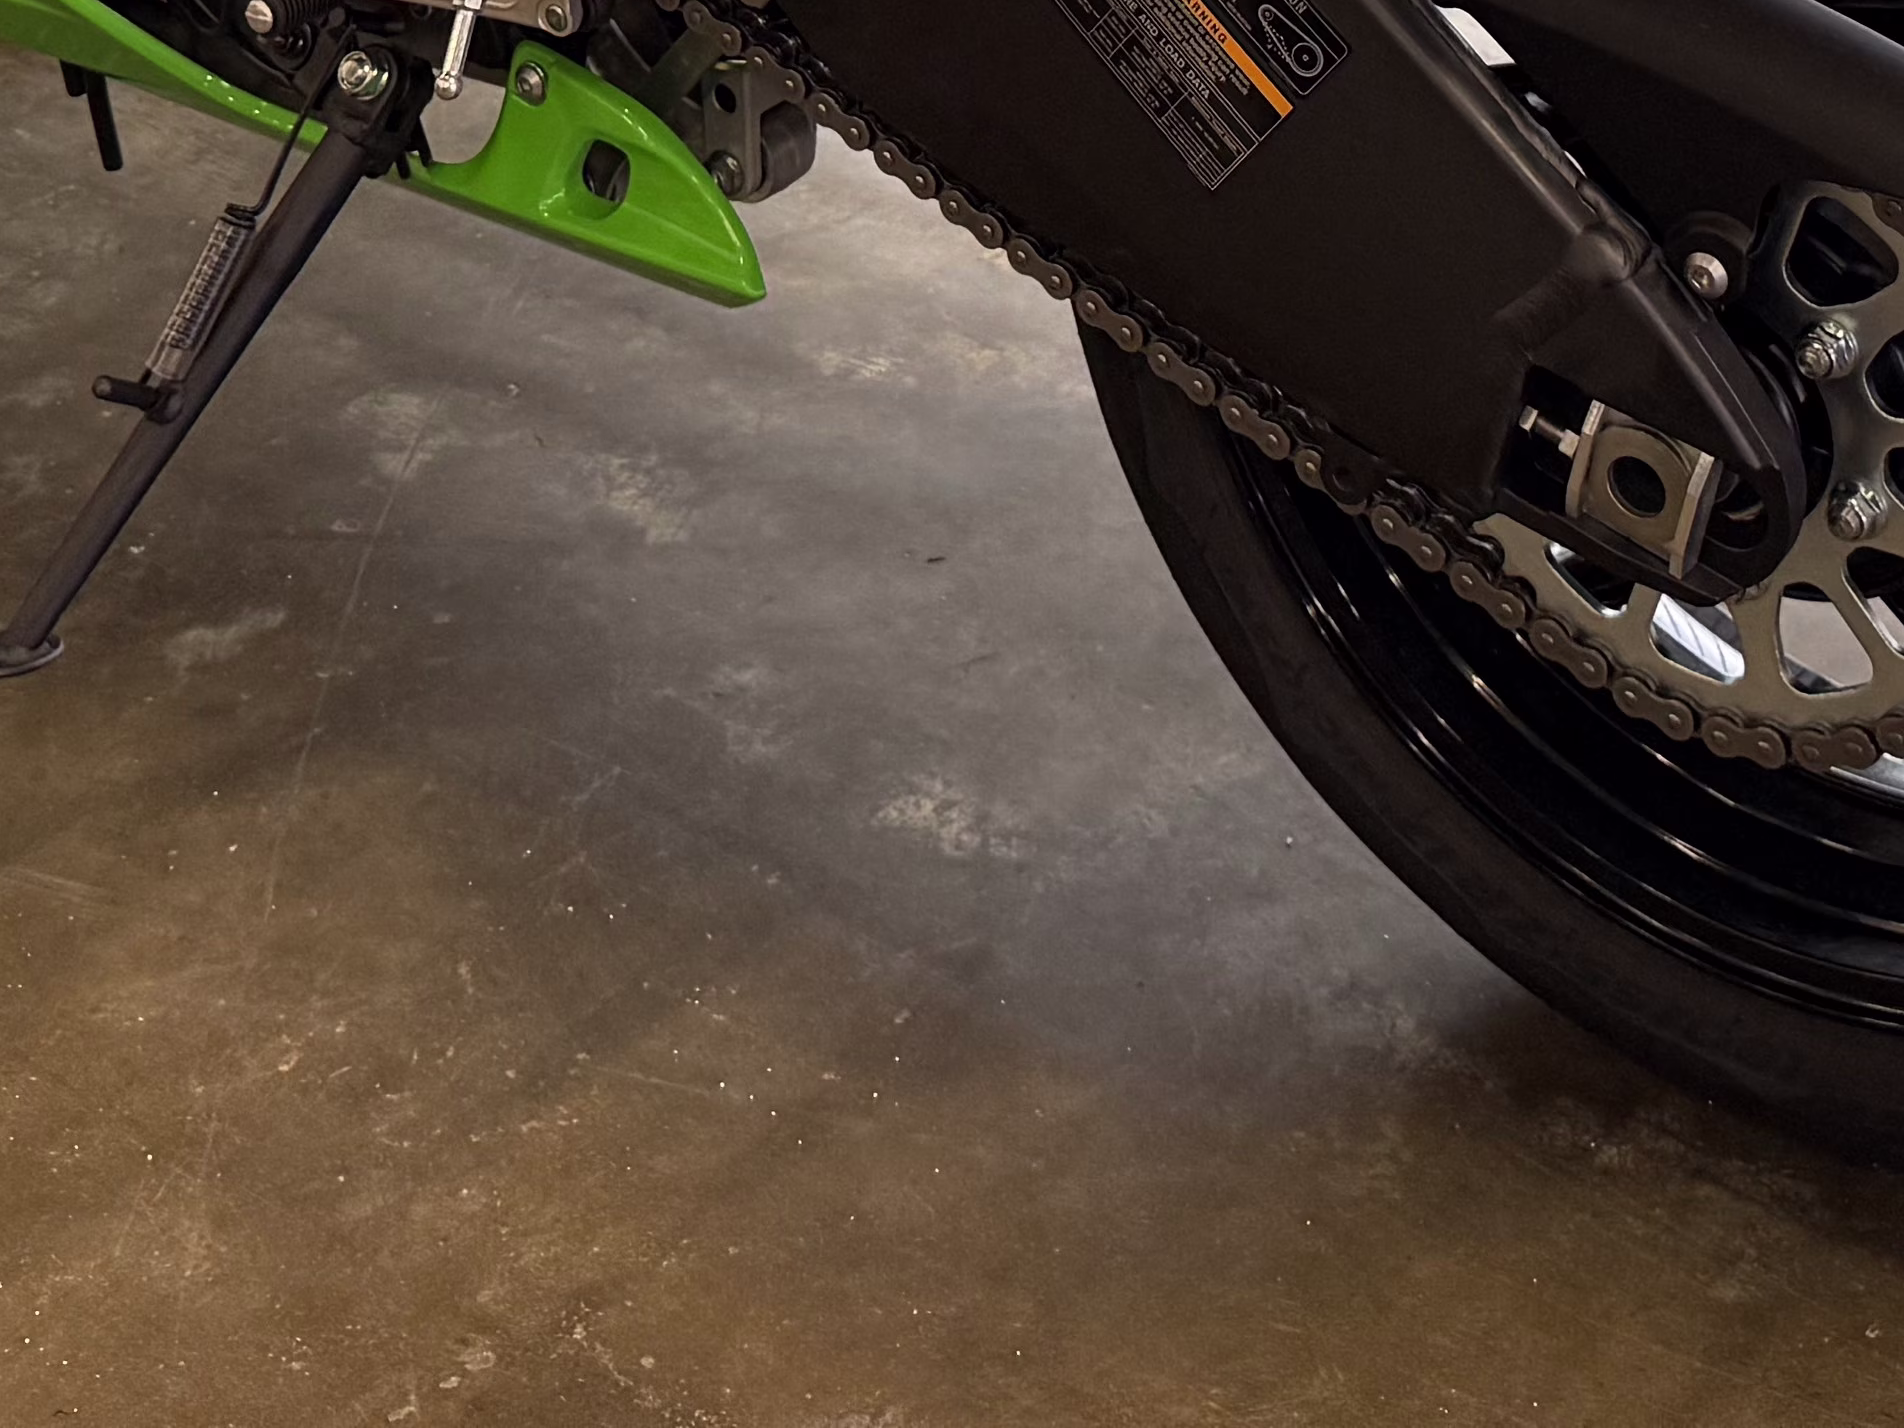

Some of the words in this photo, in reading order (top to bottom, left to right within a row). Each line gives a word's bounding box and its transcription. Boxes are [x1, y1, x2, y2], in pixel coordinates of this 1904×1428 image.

[1137, 11, 1159, 38] AND
[1159, 37, 1186, 68] LOAD
[1184, 68, 1211, 99] DATA
